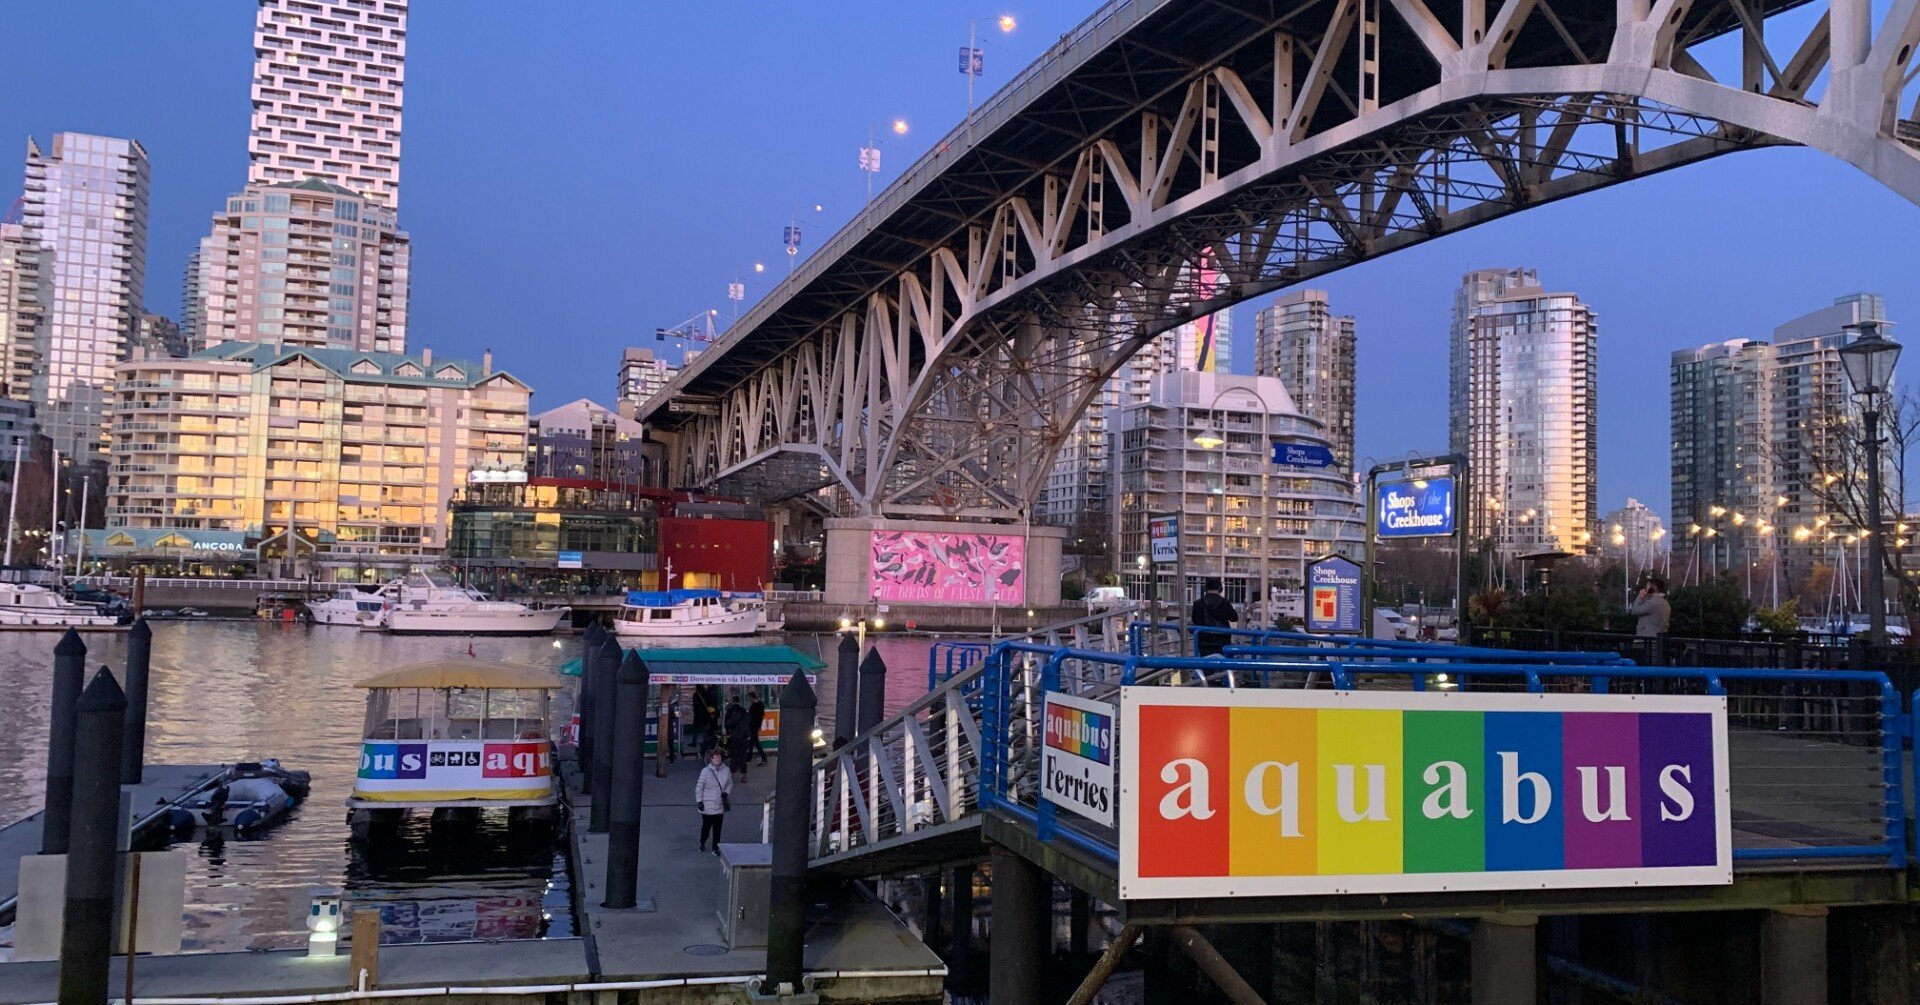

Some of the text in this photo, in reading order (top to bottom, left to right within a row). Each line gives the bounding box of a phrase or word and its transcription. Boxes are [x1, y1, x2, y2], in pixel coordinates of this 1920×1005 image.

[1286, 446, 1306, 459] Shops
[1286, 455, 1323, 465] Creekhouse
[1387, 491, 1442, 513] Shops of the
[1387, 510, 1444, 529] Creekhouse
[193, 542, 243, 550] ANCORA
[1313, 566, 1337, 577] Shops
[1313, 575, 1358, 584] Creekhouse
[898, 586, 929, 599] BIRDS
[986, 588, 1019, 601] CEEK
[740, 675, 765, 684] Hornby
[1047, 713, 1109, 750] aquabus
[1046, 755, 1108, 813] Ferries
[1158, 751, 1695, 837] aquabus
